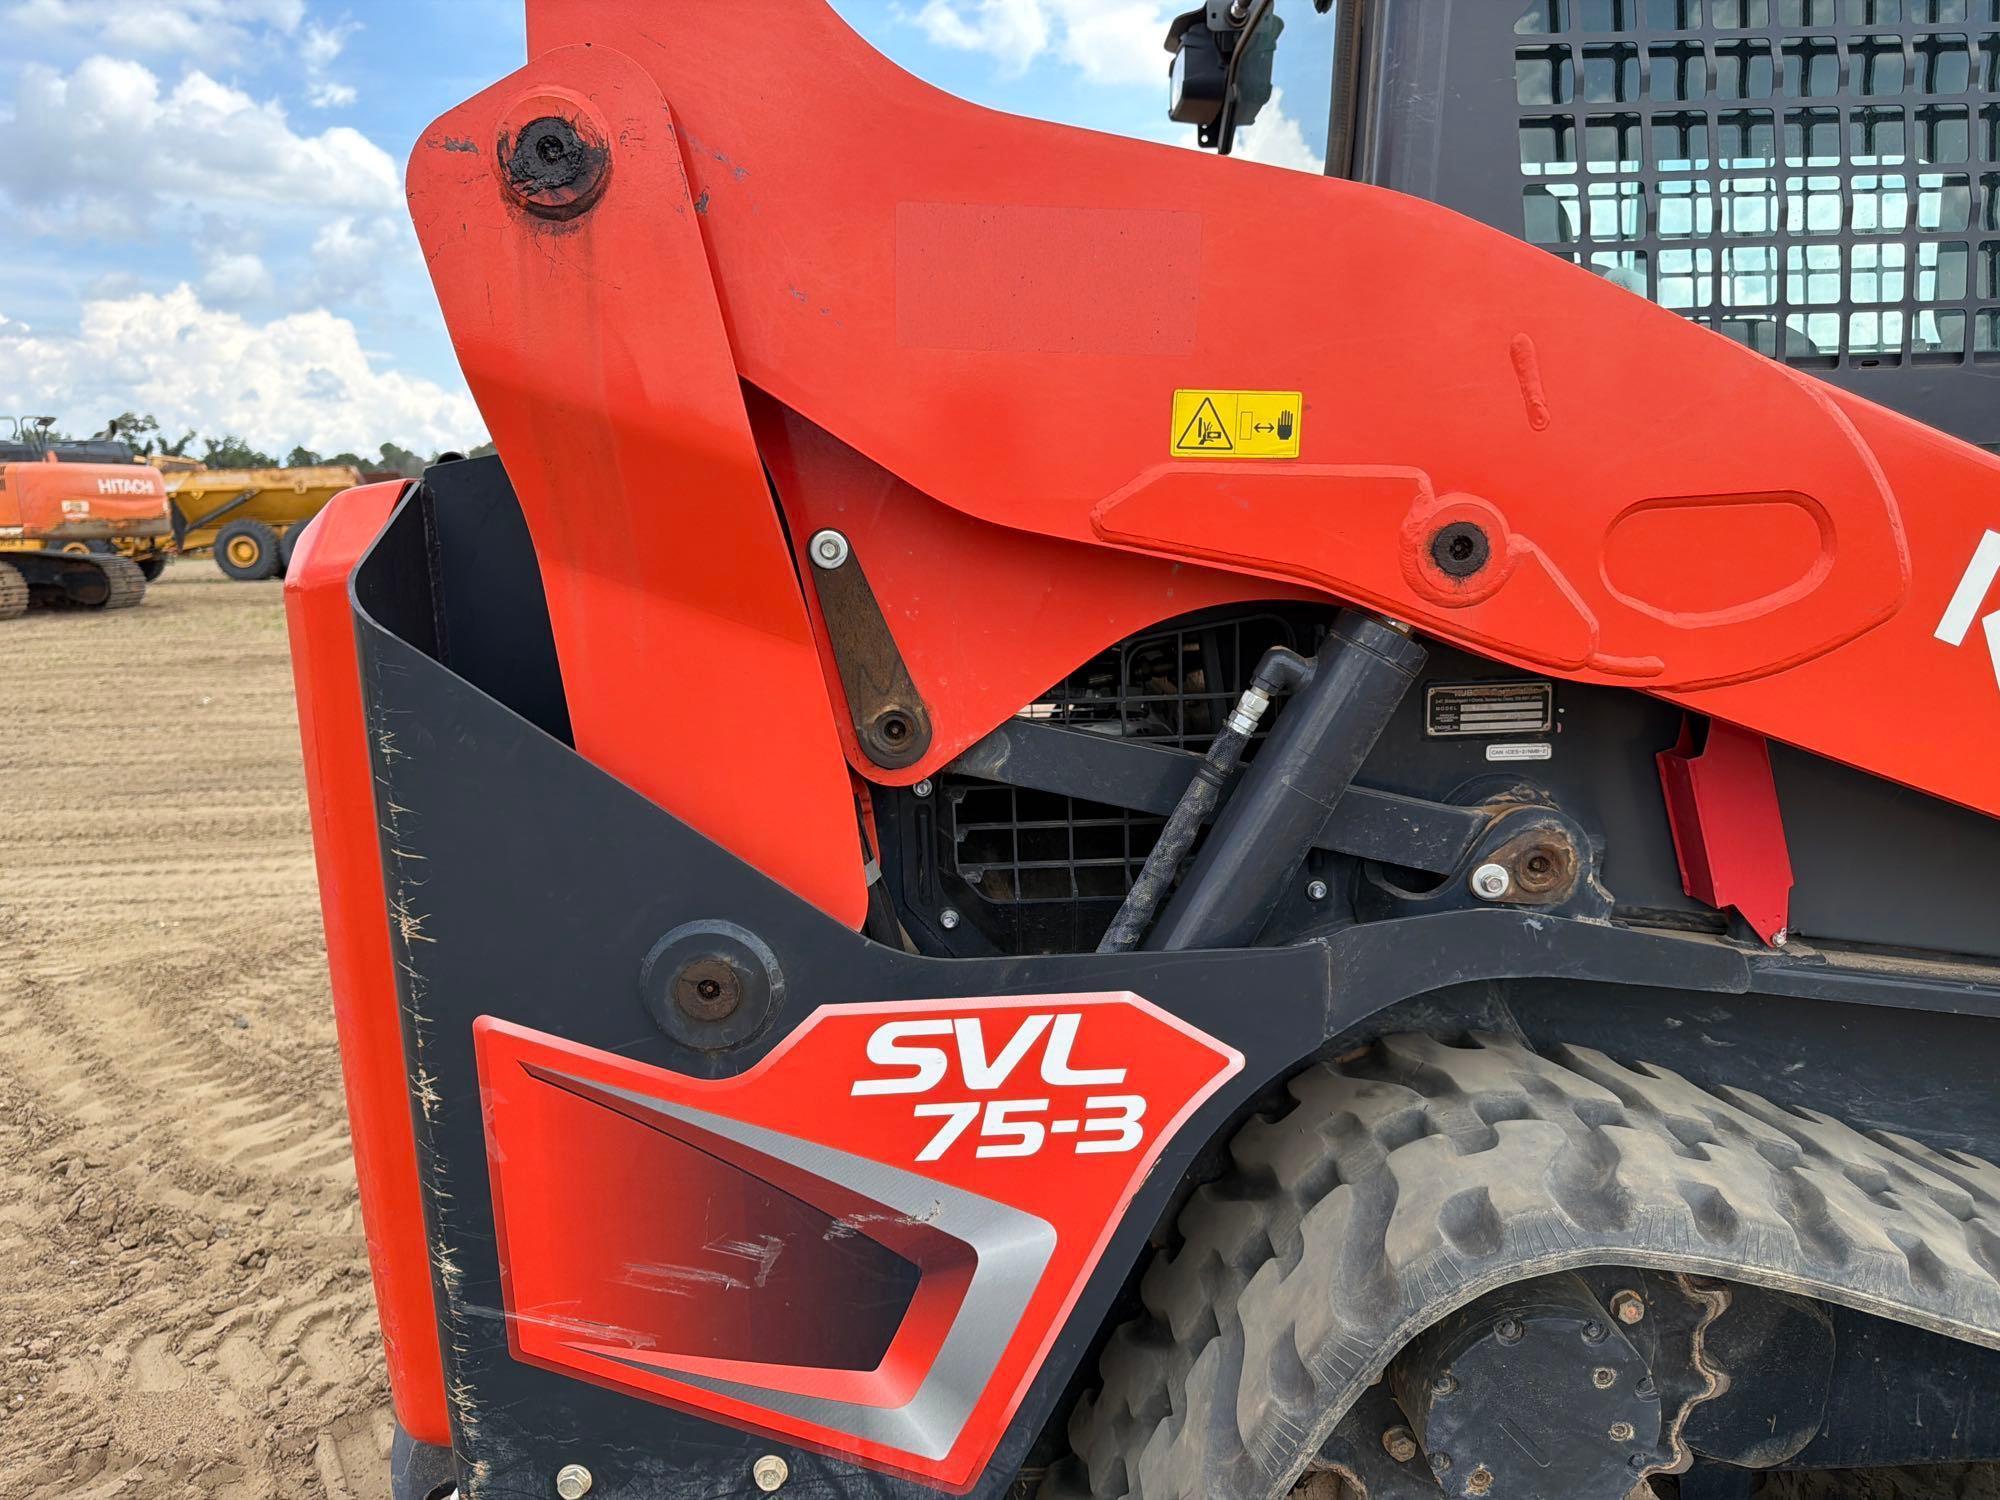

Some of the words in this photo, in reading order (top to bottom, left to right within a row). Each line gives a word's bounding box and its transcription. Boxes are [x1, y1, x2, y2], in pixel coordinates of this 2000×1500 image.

[97, 479, 154, 494] HITACHI
[850, 1013, 1127, 1096] SVL
[913, 1095, 1147, 1161] 75-3
